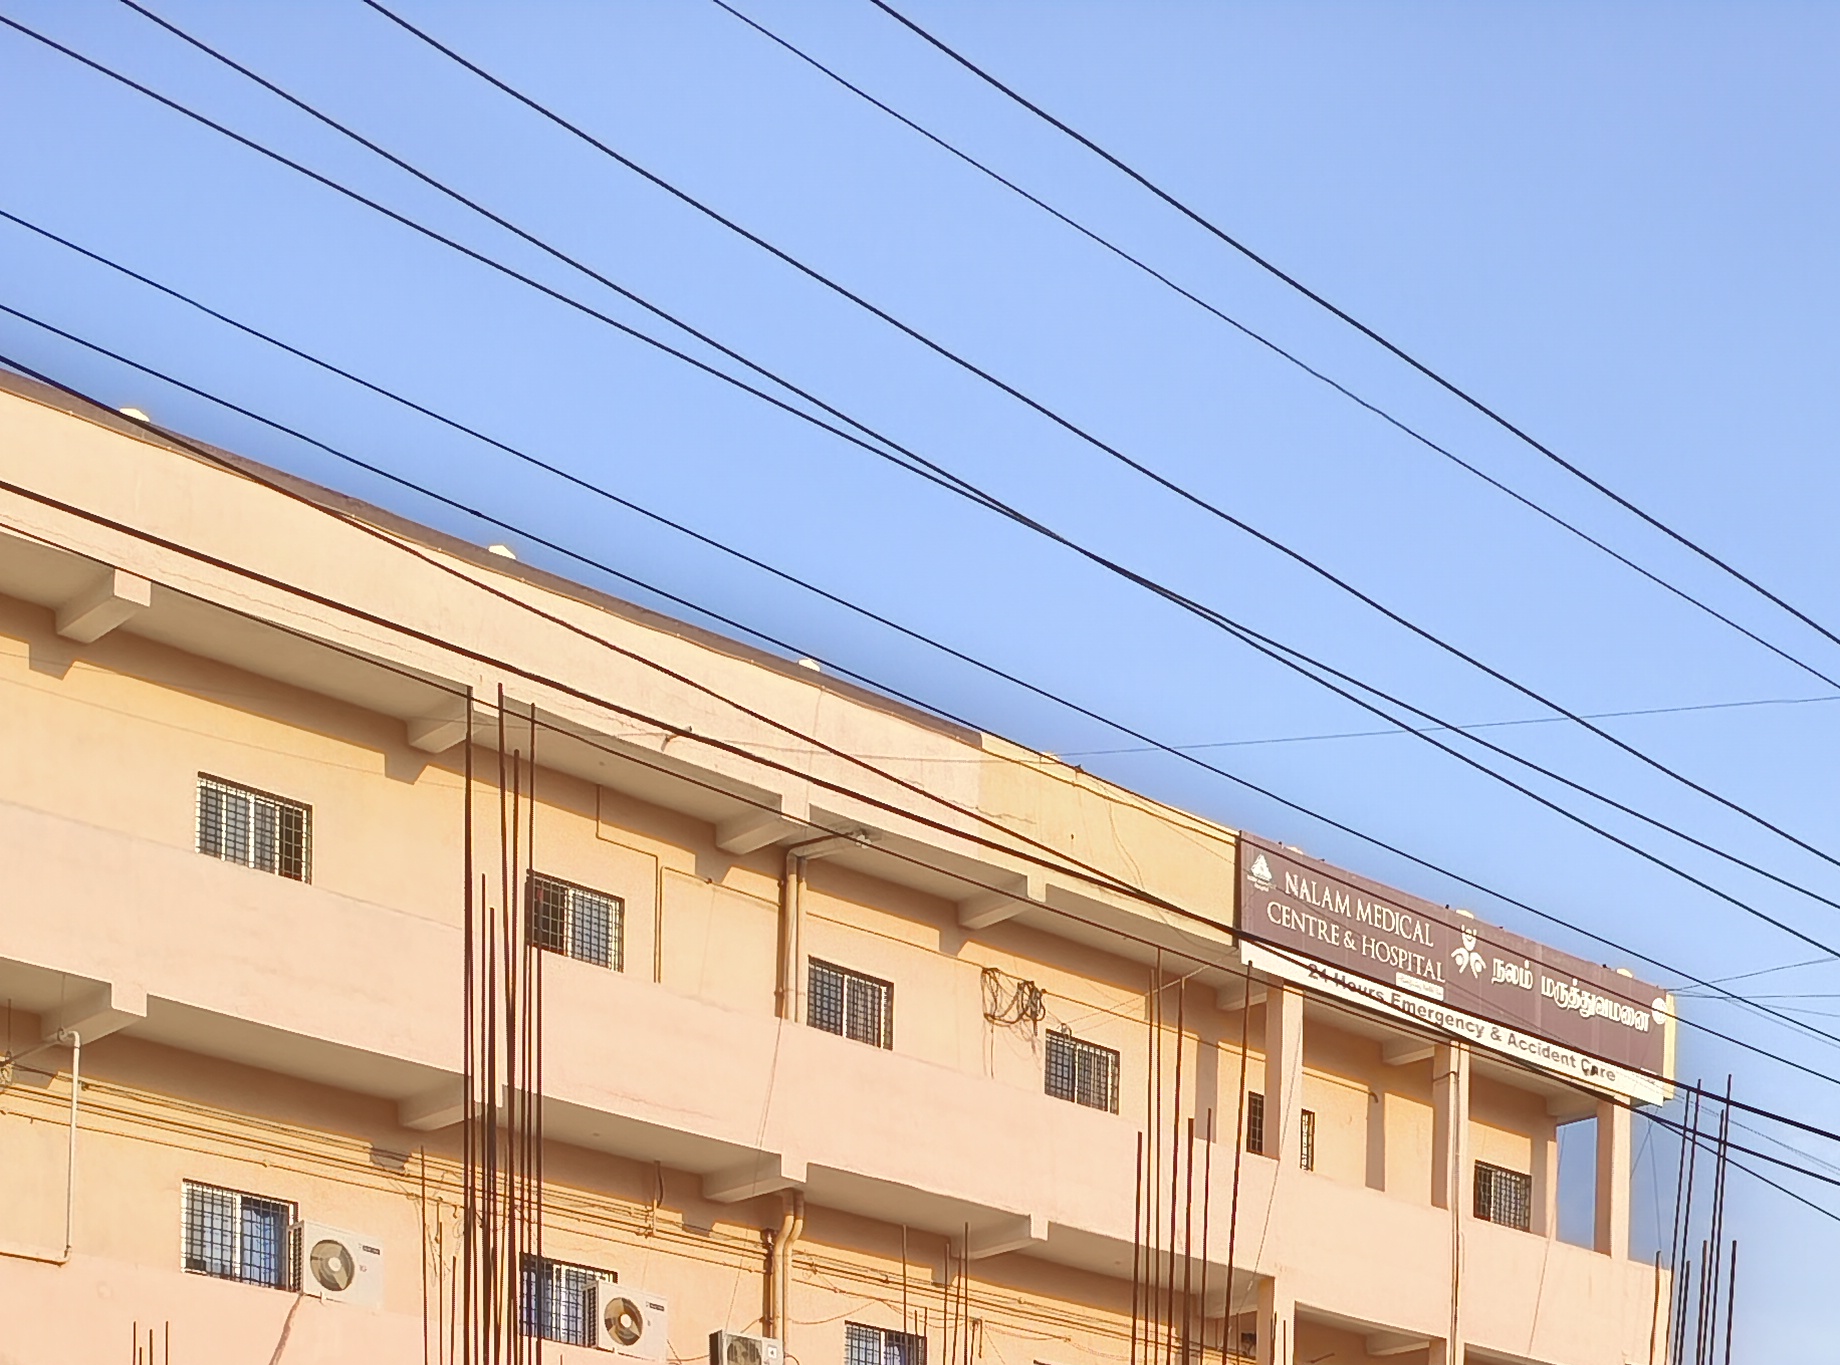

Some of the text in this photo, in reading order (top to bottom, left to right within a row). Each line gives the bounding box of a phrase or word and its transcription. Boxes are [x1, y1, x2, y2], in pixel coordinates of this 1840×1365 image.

[1267, 901, 1446, 983] CENTRE & HOSPITAL
[1285, 871, 1434, 947] NALAM MEDICAL
[1308, 963, 1328, 983] 24
[1334, 972, 1384, 1001] Hours
[1391, 992, 1484, 1039] Emergency
[1490, 1026, 1502, 1042] &
[1507, 1032, 1577, 1069] Accident
[1491, 957, 1534, 990] நலம்
[1541, 977, 1651, 1032] மருத்துவமனை
